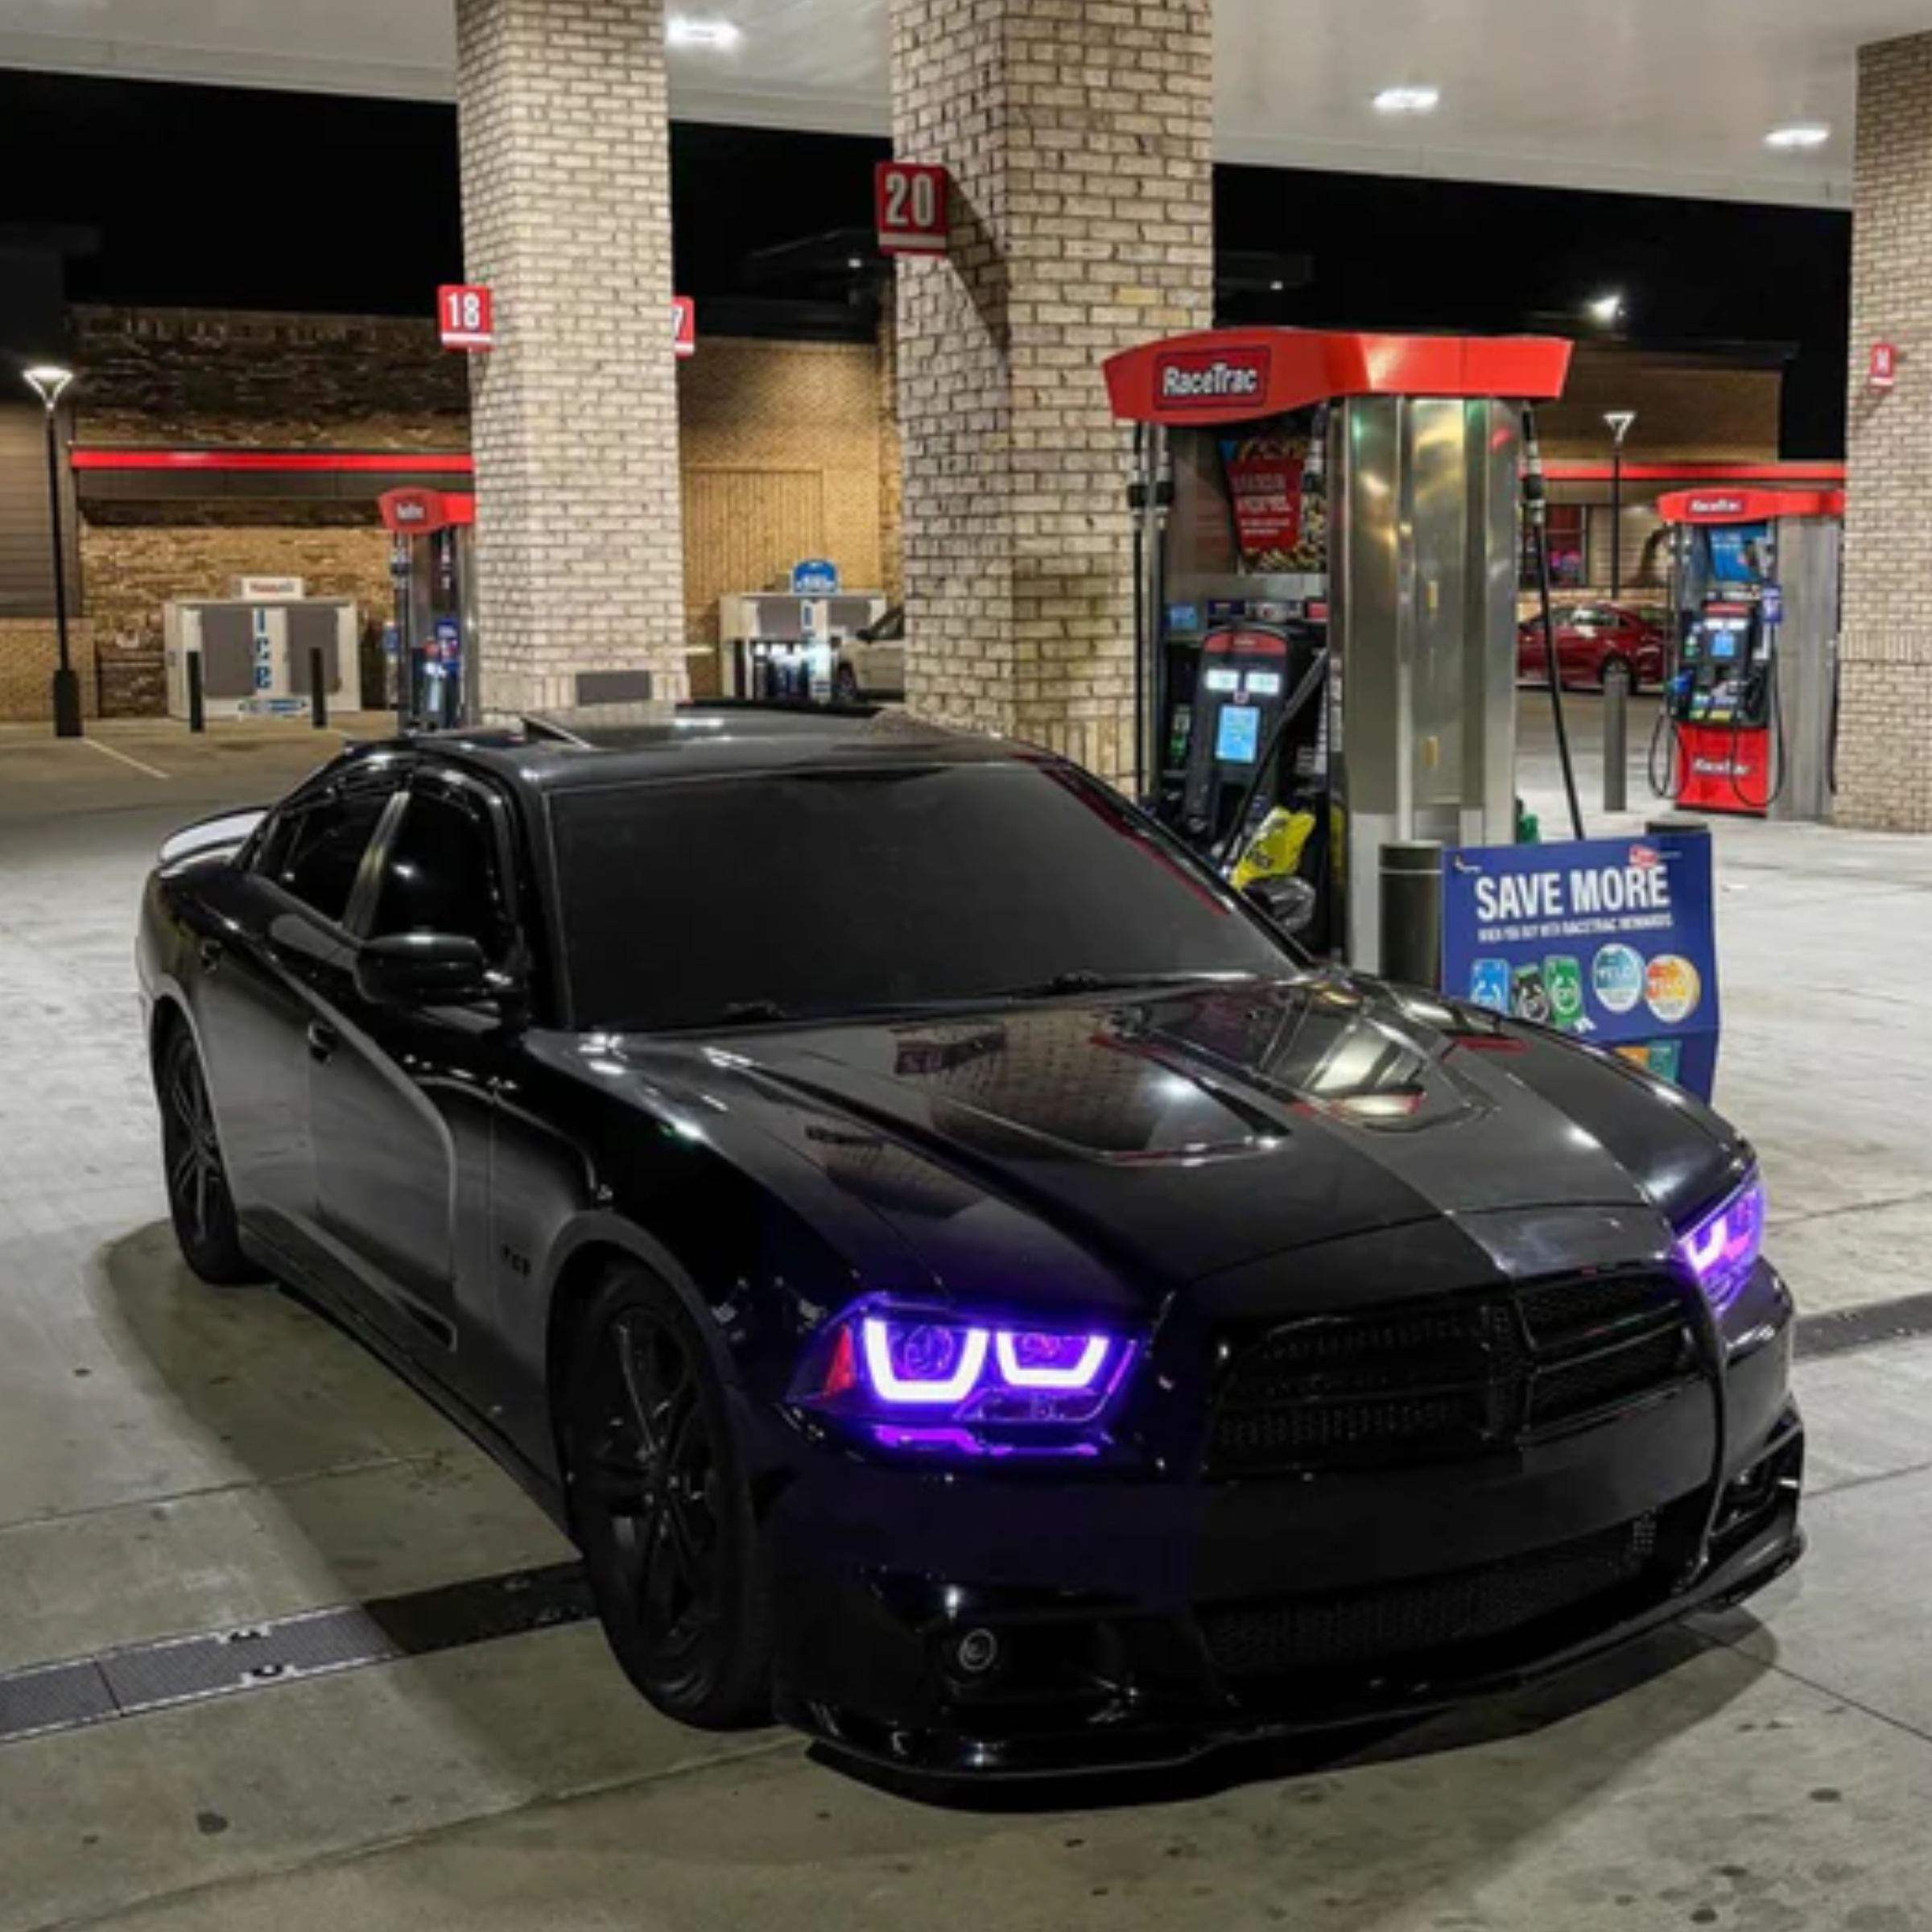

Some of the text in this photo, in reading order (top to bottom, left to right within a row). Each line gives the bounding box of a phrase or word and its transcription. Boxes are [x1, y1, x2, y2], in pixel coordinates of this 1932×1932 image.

[886, 171, 934, 226] 20
[448, 292, 480, 328] 18
[1162, 362, 1258, 397] RaceTrac
[1475, 864, 1671, 922] SAVE MORE
